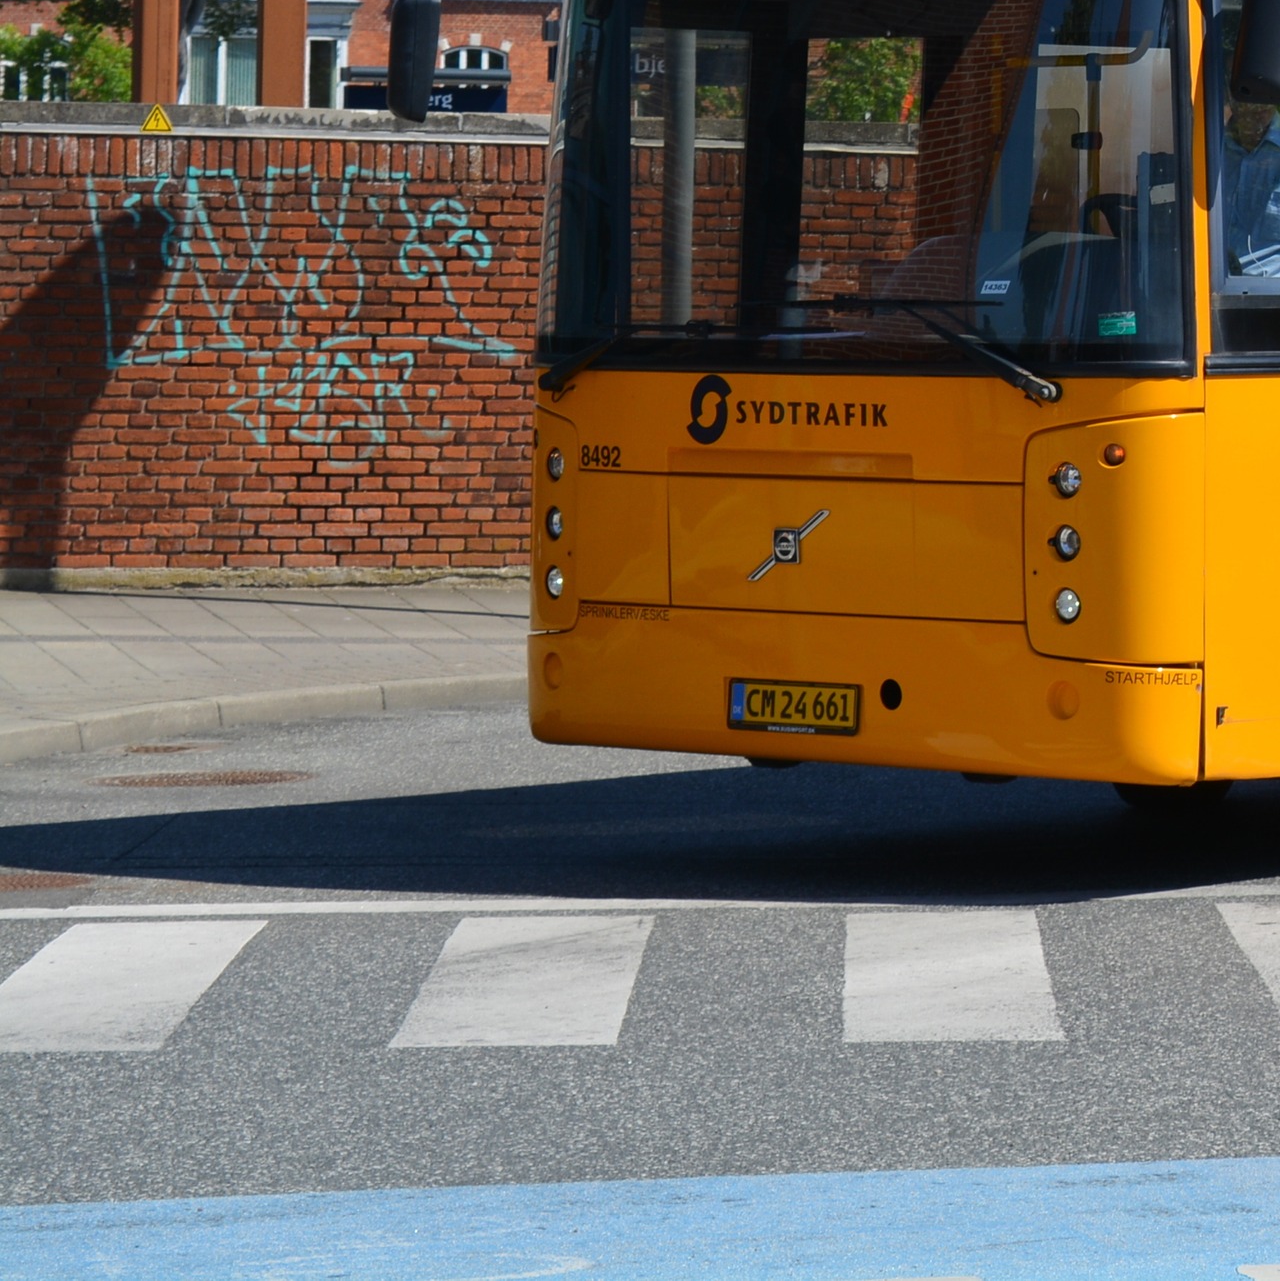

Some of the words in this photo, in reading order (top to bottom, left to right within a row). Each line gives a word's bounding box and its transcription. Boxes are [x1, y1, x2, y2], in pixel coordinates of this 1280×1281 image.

[634, 54, 665, 78] bje
[428, 94, 453, 110] erg
[735, 400, 888, 427] SYDTRAFIK
[581, 445, 621, 467] 8492
[580, 605, 670, 621] SPRINKLERVÆSKE
[1105, 670, 1198, 686] STARTHJÆLP
[746, 689, 776, 718] CM
[780, 690, 807, 719] 24
[812, 691, 849, 722] 661
